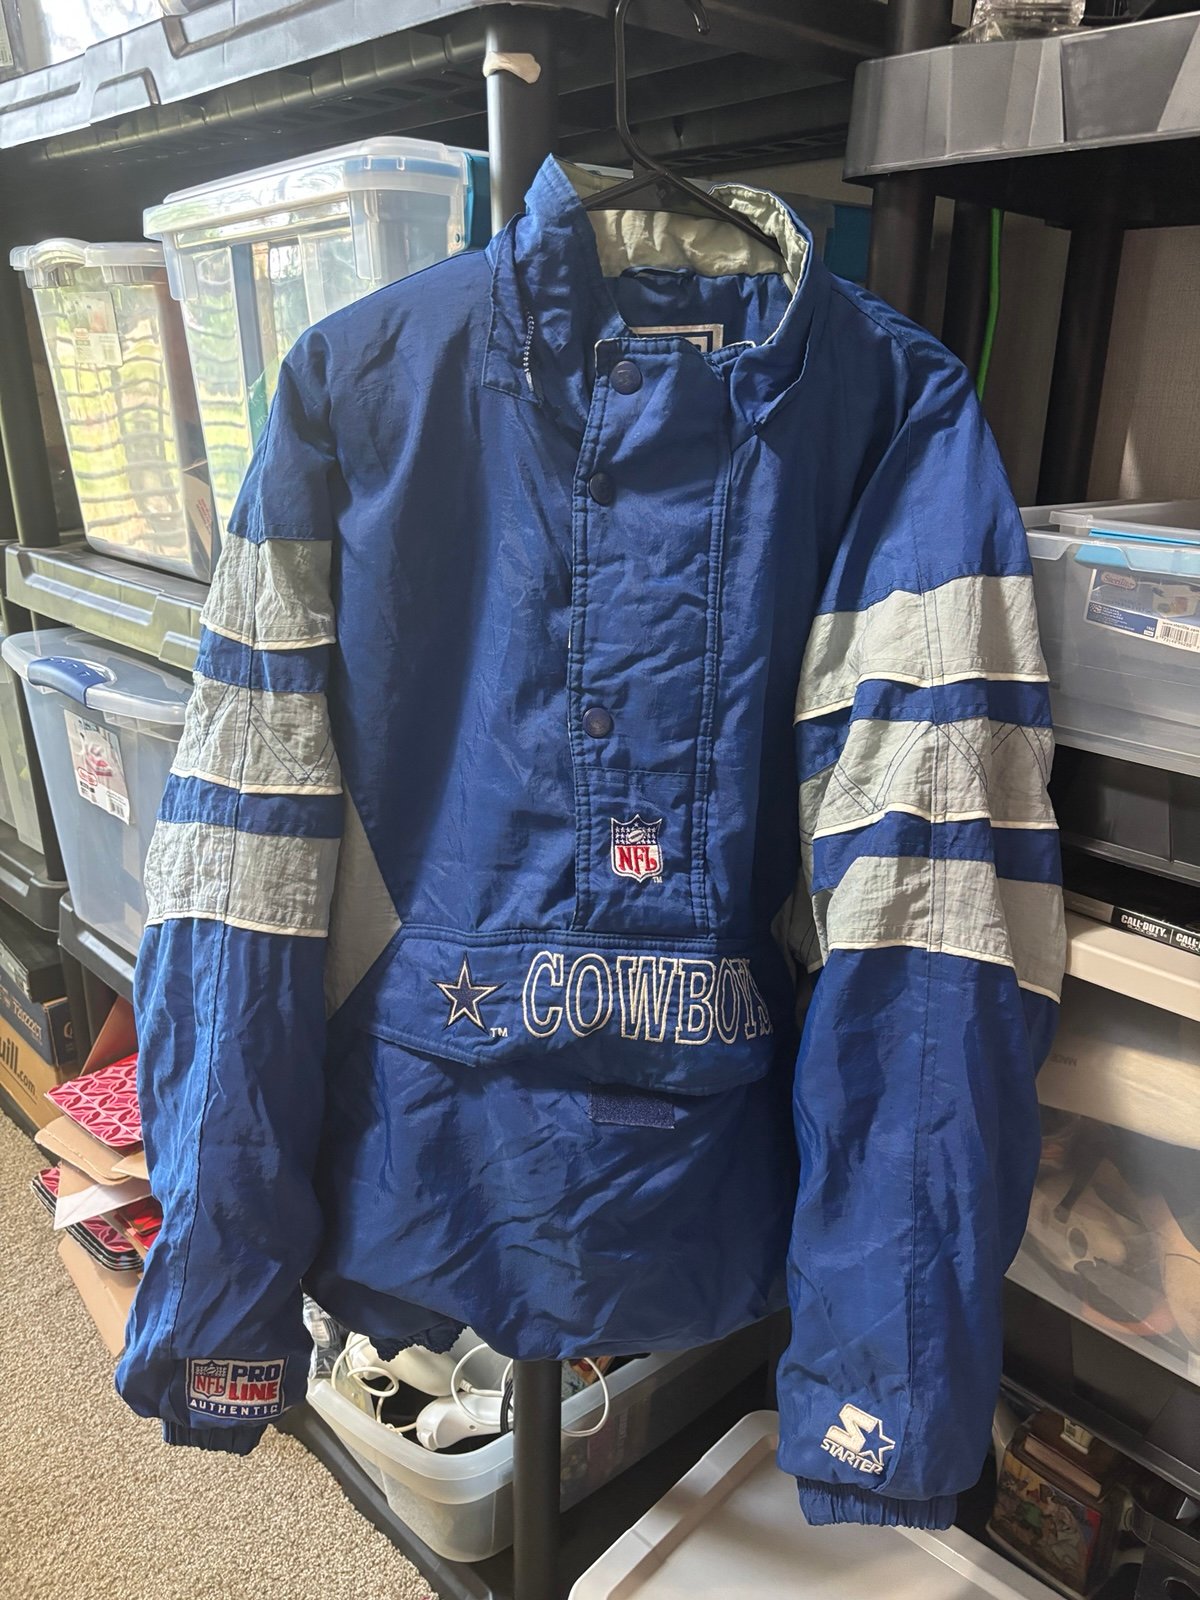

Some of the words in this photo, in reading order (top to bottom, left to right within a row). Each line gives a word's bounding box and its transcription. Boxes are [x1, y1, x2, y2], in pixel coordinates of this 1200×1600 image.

[616, 846, 658, 876] NFL
[1121, 914, 1142, 927] CALL
[490, 1027, 508, 1038] TM
[232, 1364, 281, 1382] PRO
[195, 1375, 225, 1395] NFL
[229, 1382, 278, 1401] LINE
[189, 1398, 279, 1416] AUTHENTIC
[820, 1437, 884, 1475] STARTER
